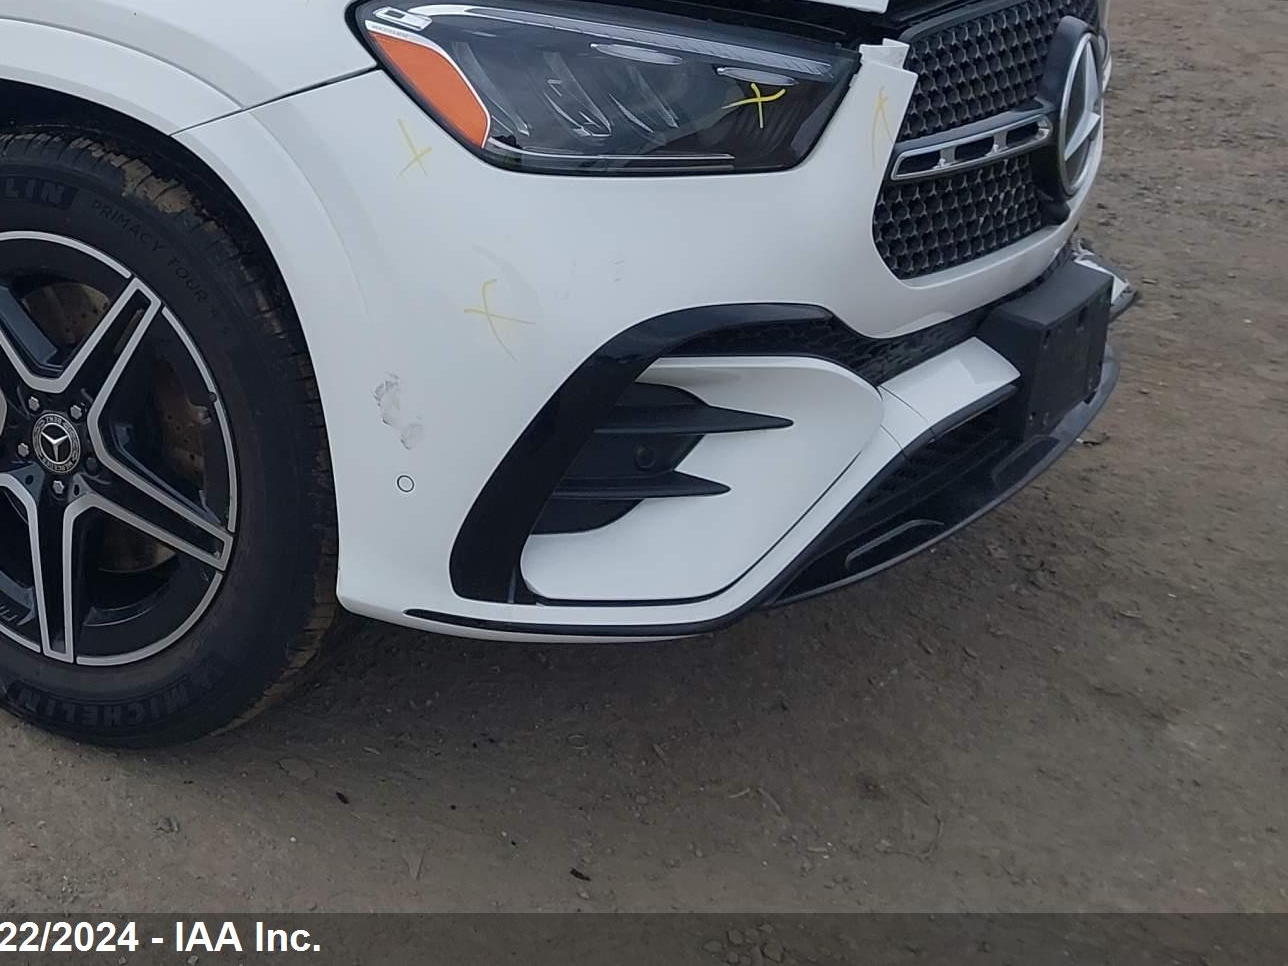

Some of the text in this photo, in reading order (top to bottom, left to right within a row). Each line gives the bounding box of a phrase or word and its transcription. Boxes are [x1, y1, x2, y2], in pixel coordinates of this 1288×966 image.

[90, 199, 210, 304] PRIMACY TOUR
[17, 682, 192, 730] MICHELIN
